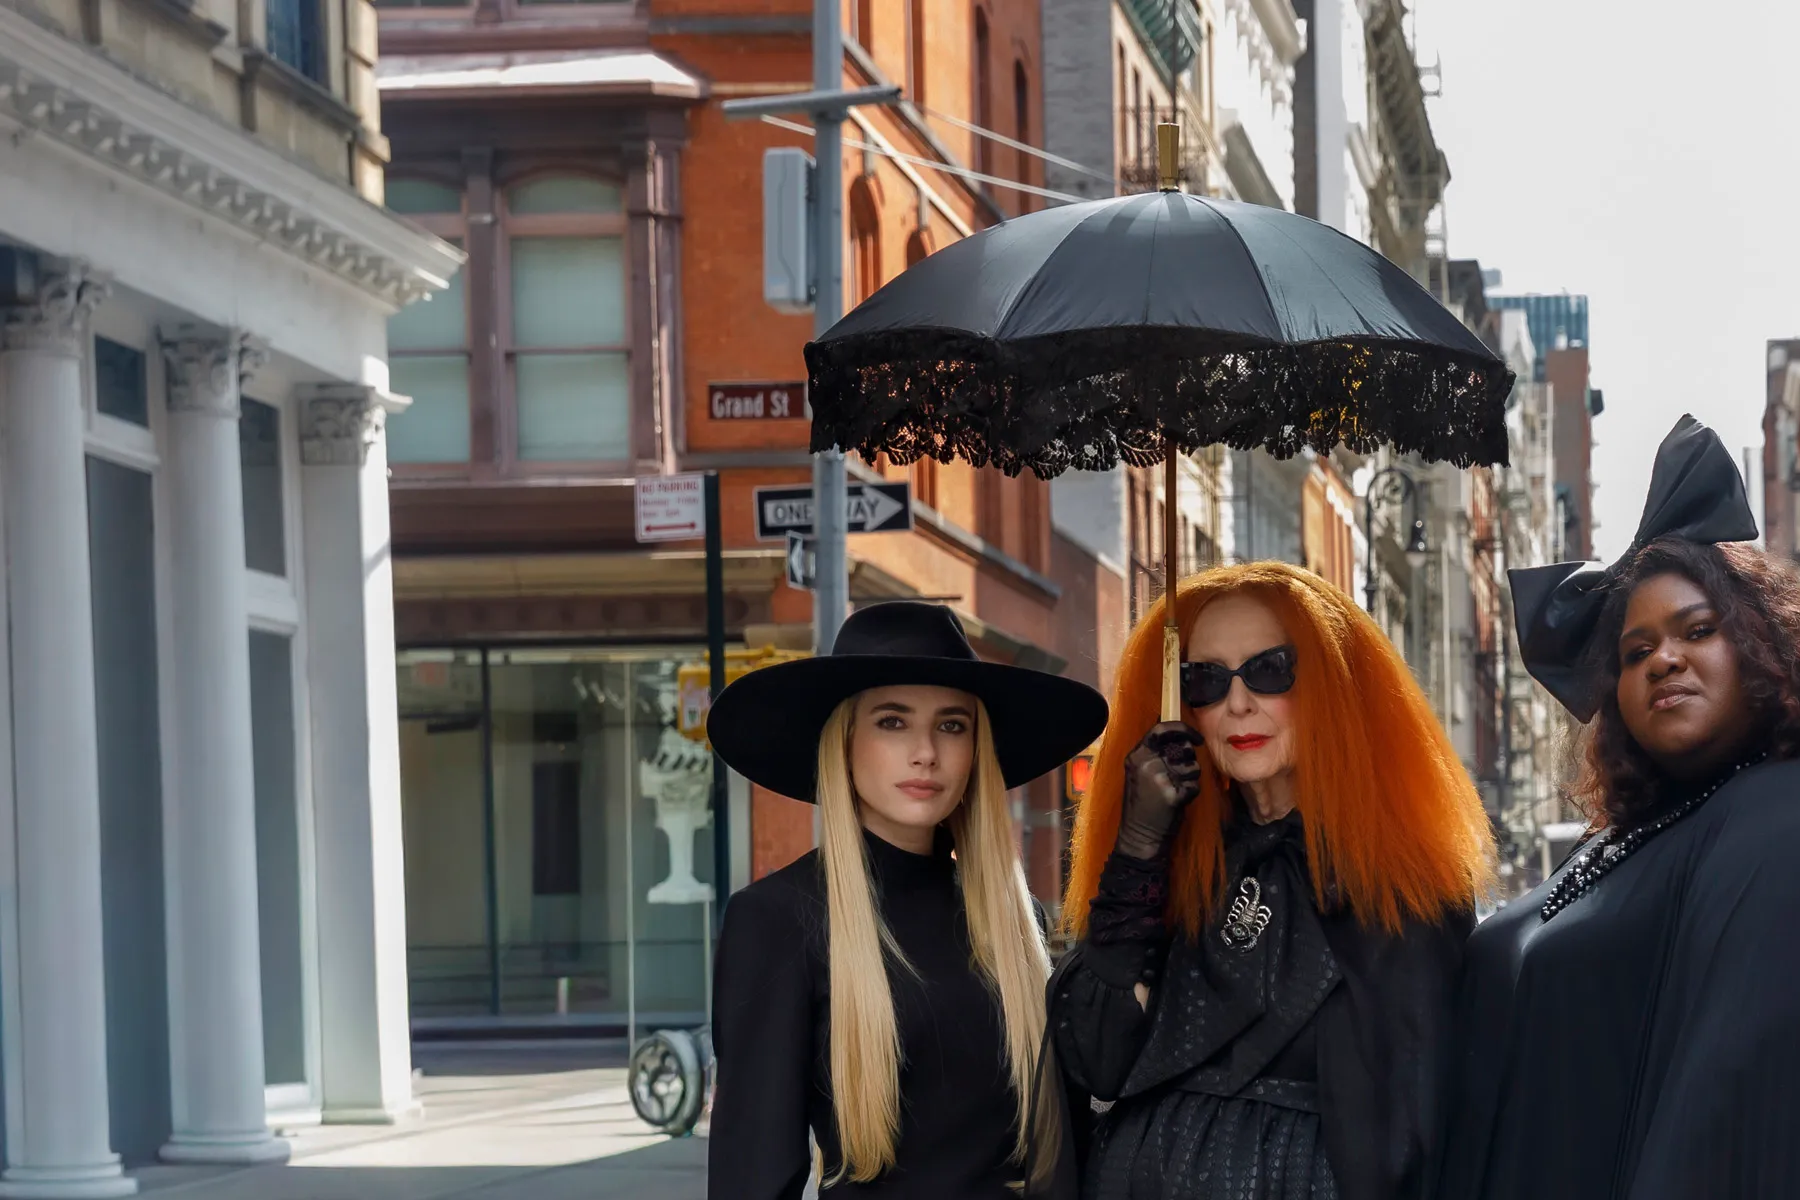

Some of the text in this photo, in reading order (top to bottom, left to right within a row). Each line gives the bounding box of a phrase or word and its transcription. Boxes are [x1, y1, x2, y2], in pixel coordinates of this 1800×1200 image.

[712, 390, 789, 418] Grand St
[774, 504, 813, 525] ONE
